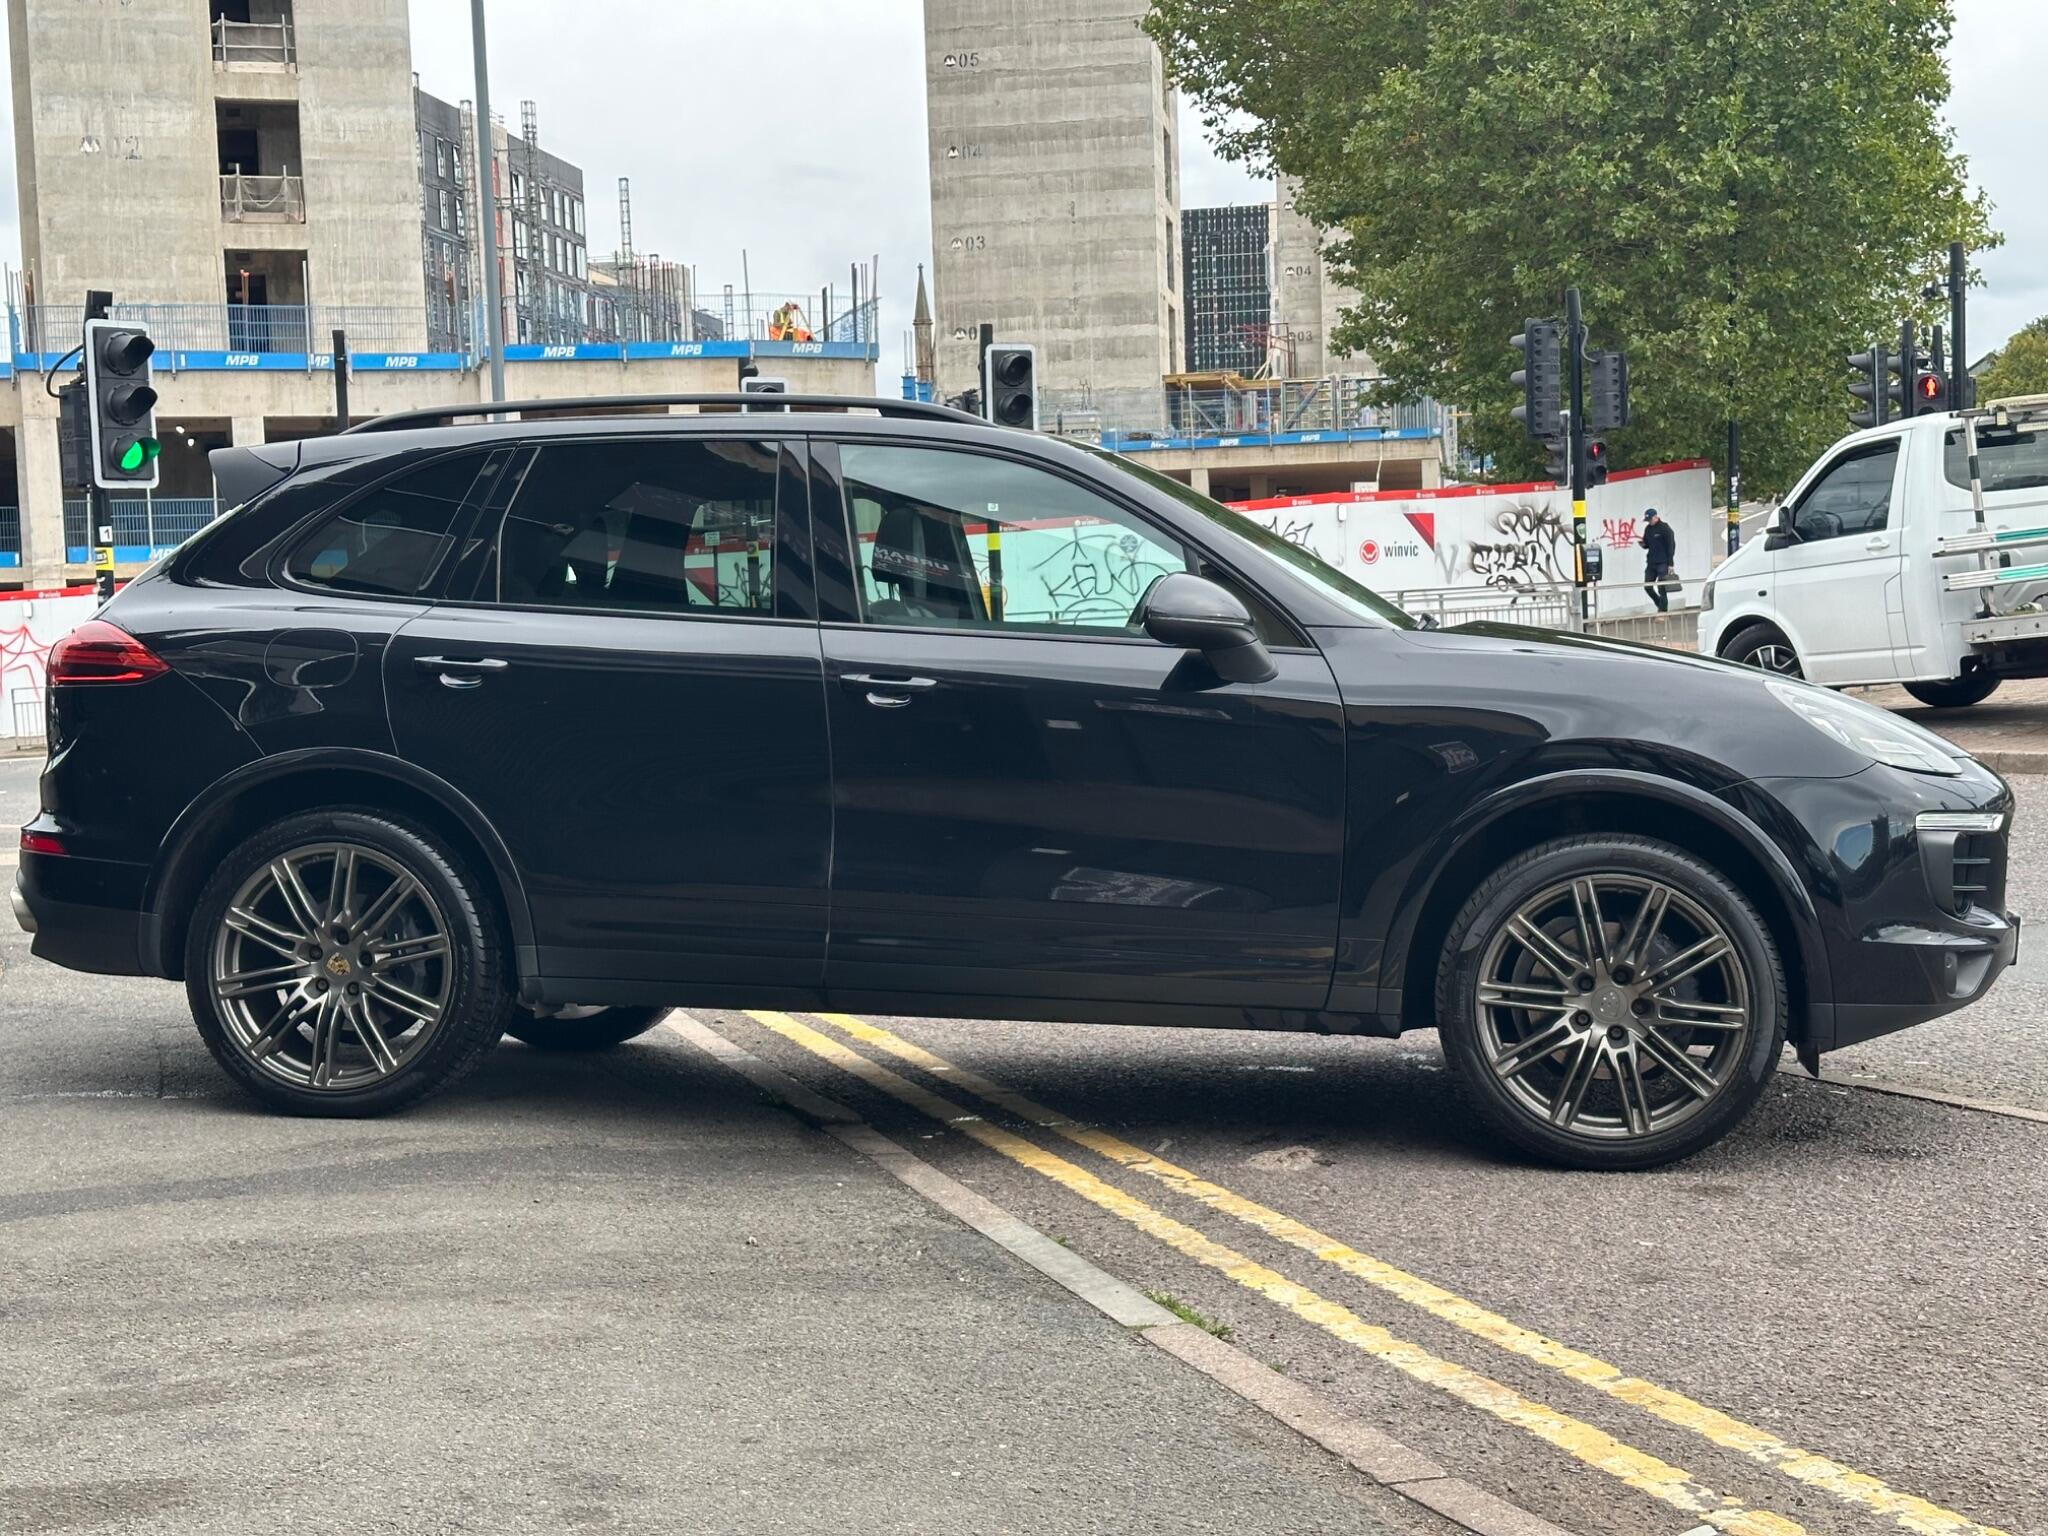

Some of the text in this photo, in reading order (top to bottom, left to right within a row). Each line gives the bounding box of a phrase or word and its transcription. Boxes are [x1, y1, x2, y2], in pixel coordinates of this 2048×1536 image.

[959, 52, 979, 68] 05
[962, 145, 982, 159] 04
[965, 235, 986, 251] 03
[1295, 265, 1312, 277] 04
[1297, 330, 1313, 342] 03
[543, 345, 577, 358] MPB
[671, 343, 703, 356] MPB
[792, 342, 823, 354] MPB
[225, 354, 260, 366] MPB
[309, 354, 331, 367] MP
[385, 356, 418, 367] MPB
[1384, 540, 1419, 557] winvic
